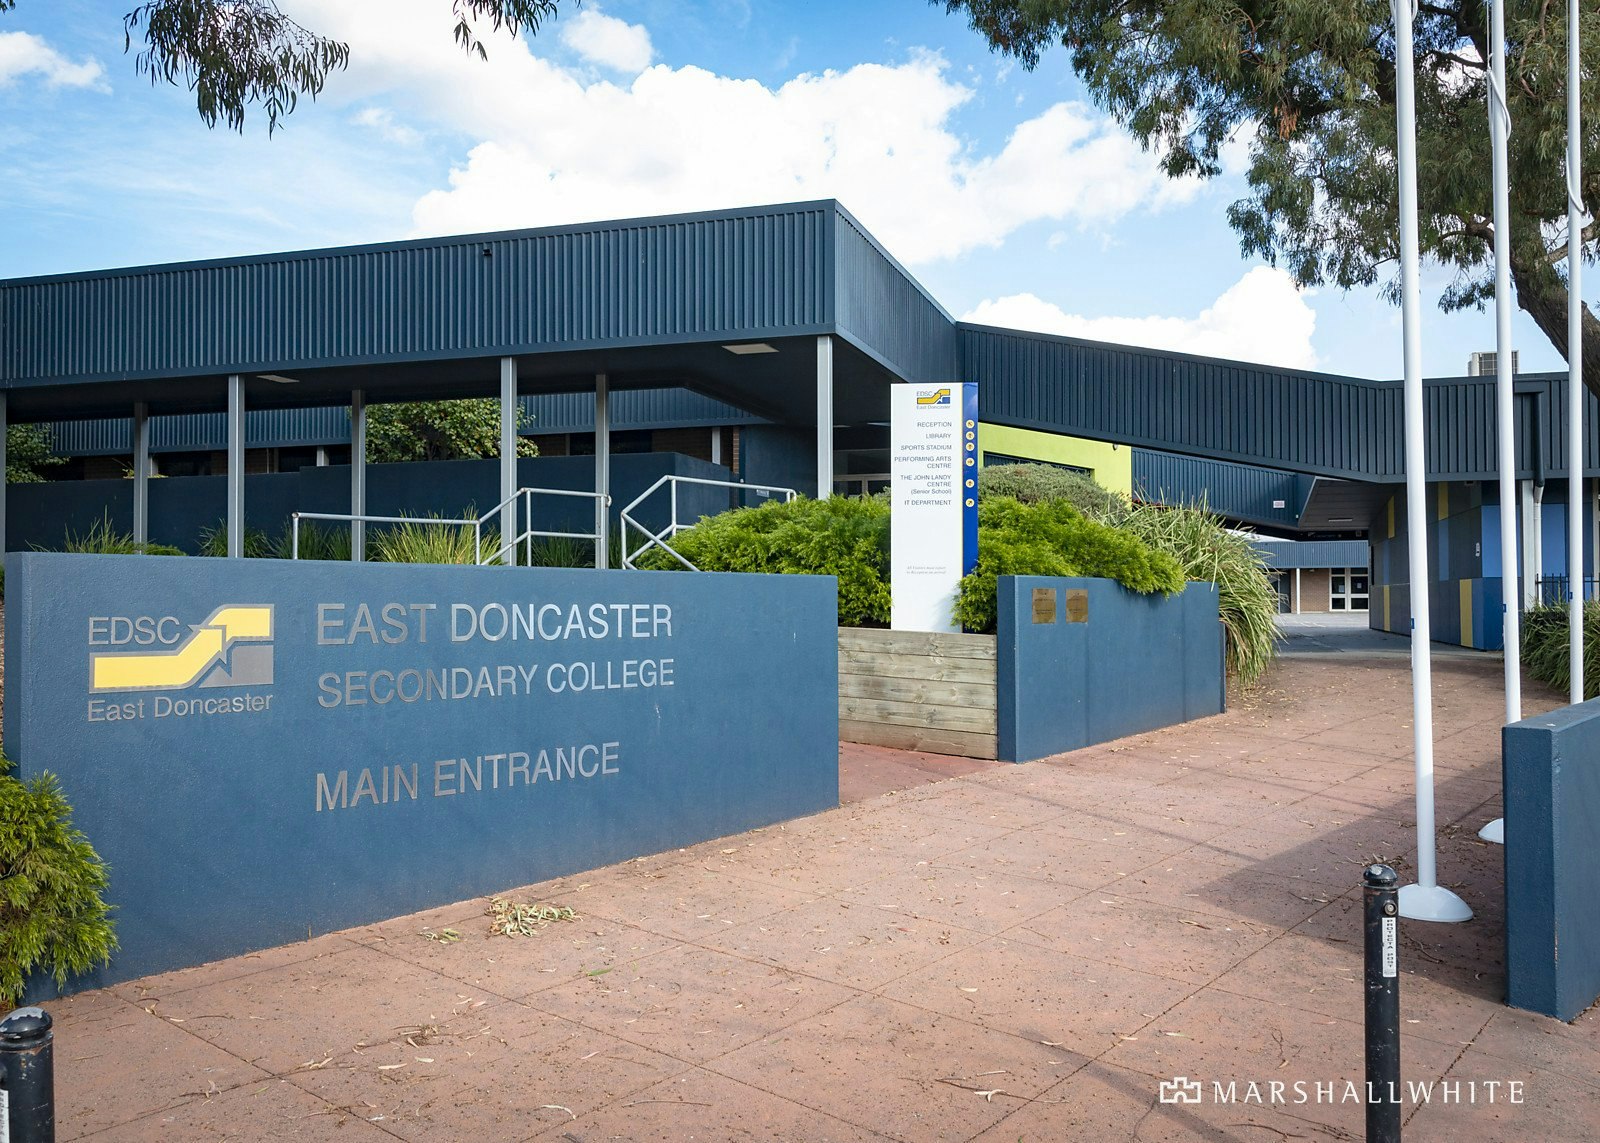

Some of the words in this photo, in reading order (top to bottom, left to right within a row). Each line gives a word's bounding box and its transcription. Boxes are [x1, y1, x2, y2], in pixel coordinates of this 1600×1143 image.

[88, 616, 181, 646] EDSC
[316, 602, 437, 645] EAST
[451, 602, 673, 643] DONCASTER
[317, 664, 538, 708] SECONDARY
[546, 658, 675, 693] COLLEGE
[87, 699, 145, 722] East
[154, 694, 274, 718] Doncaster
[315, 762, 418, 812] MAIN
[434, 741, 620, 797] ENTRANCE
[1386, 919, 1394, 949] PROTECTA
[1386, 953, 1394, 968] POST
